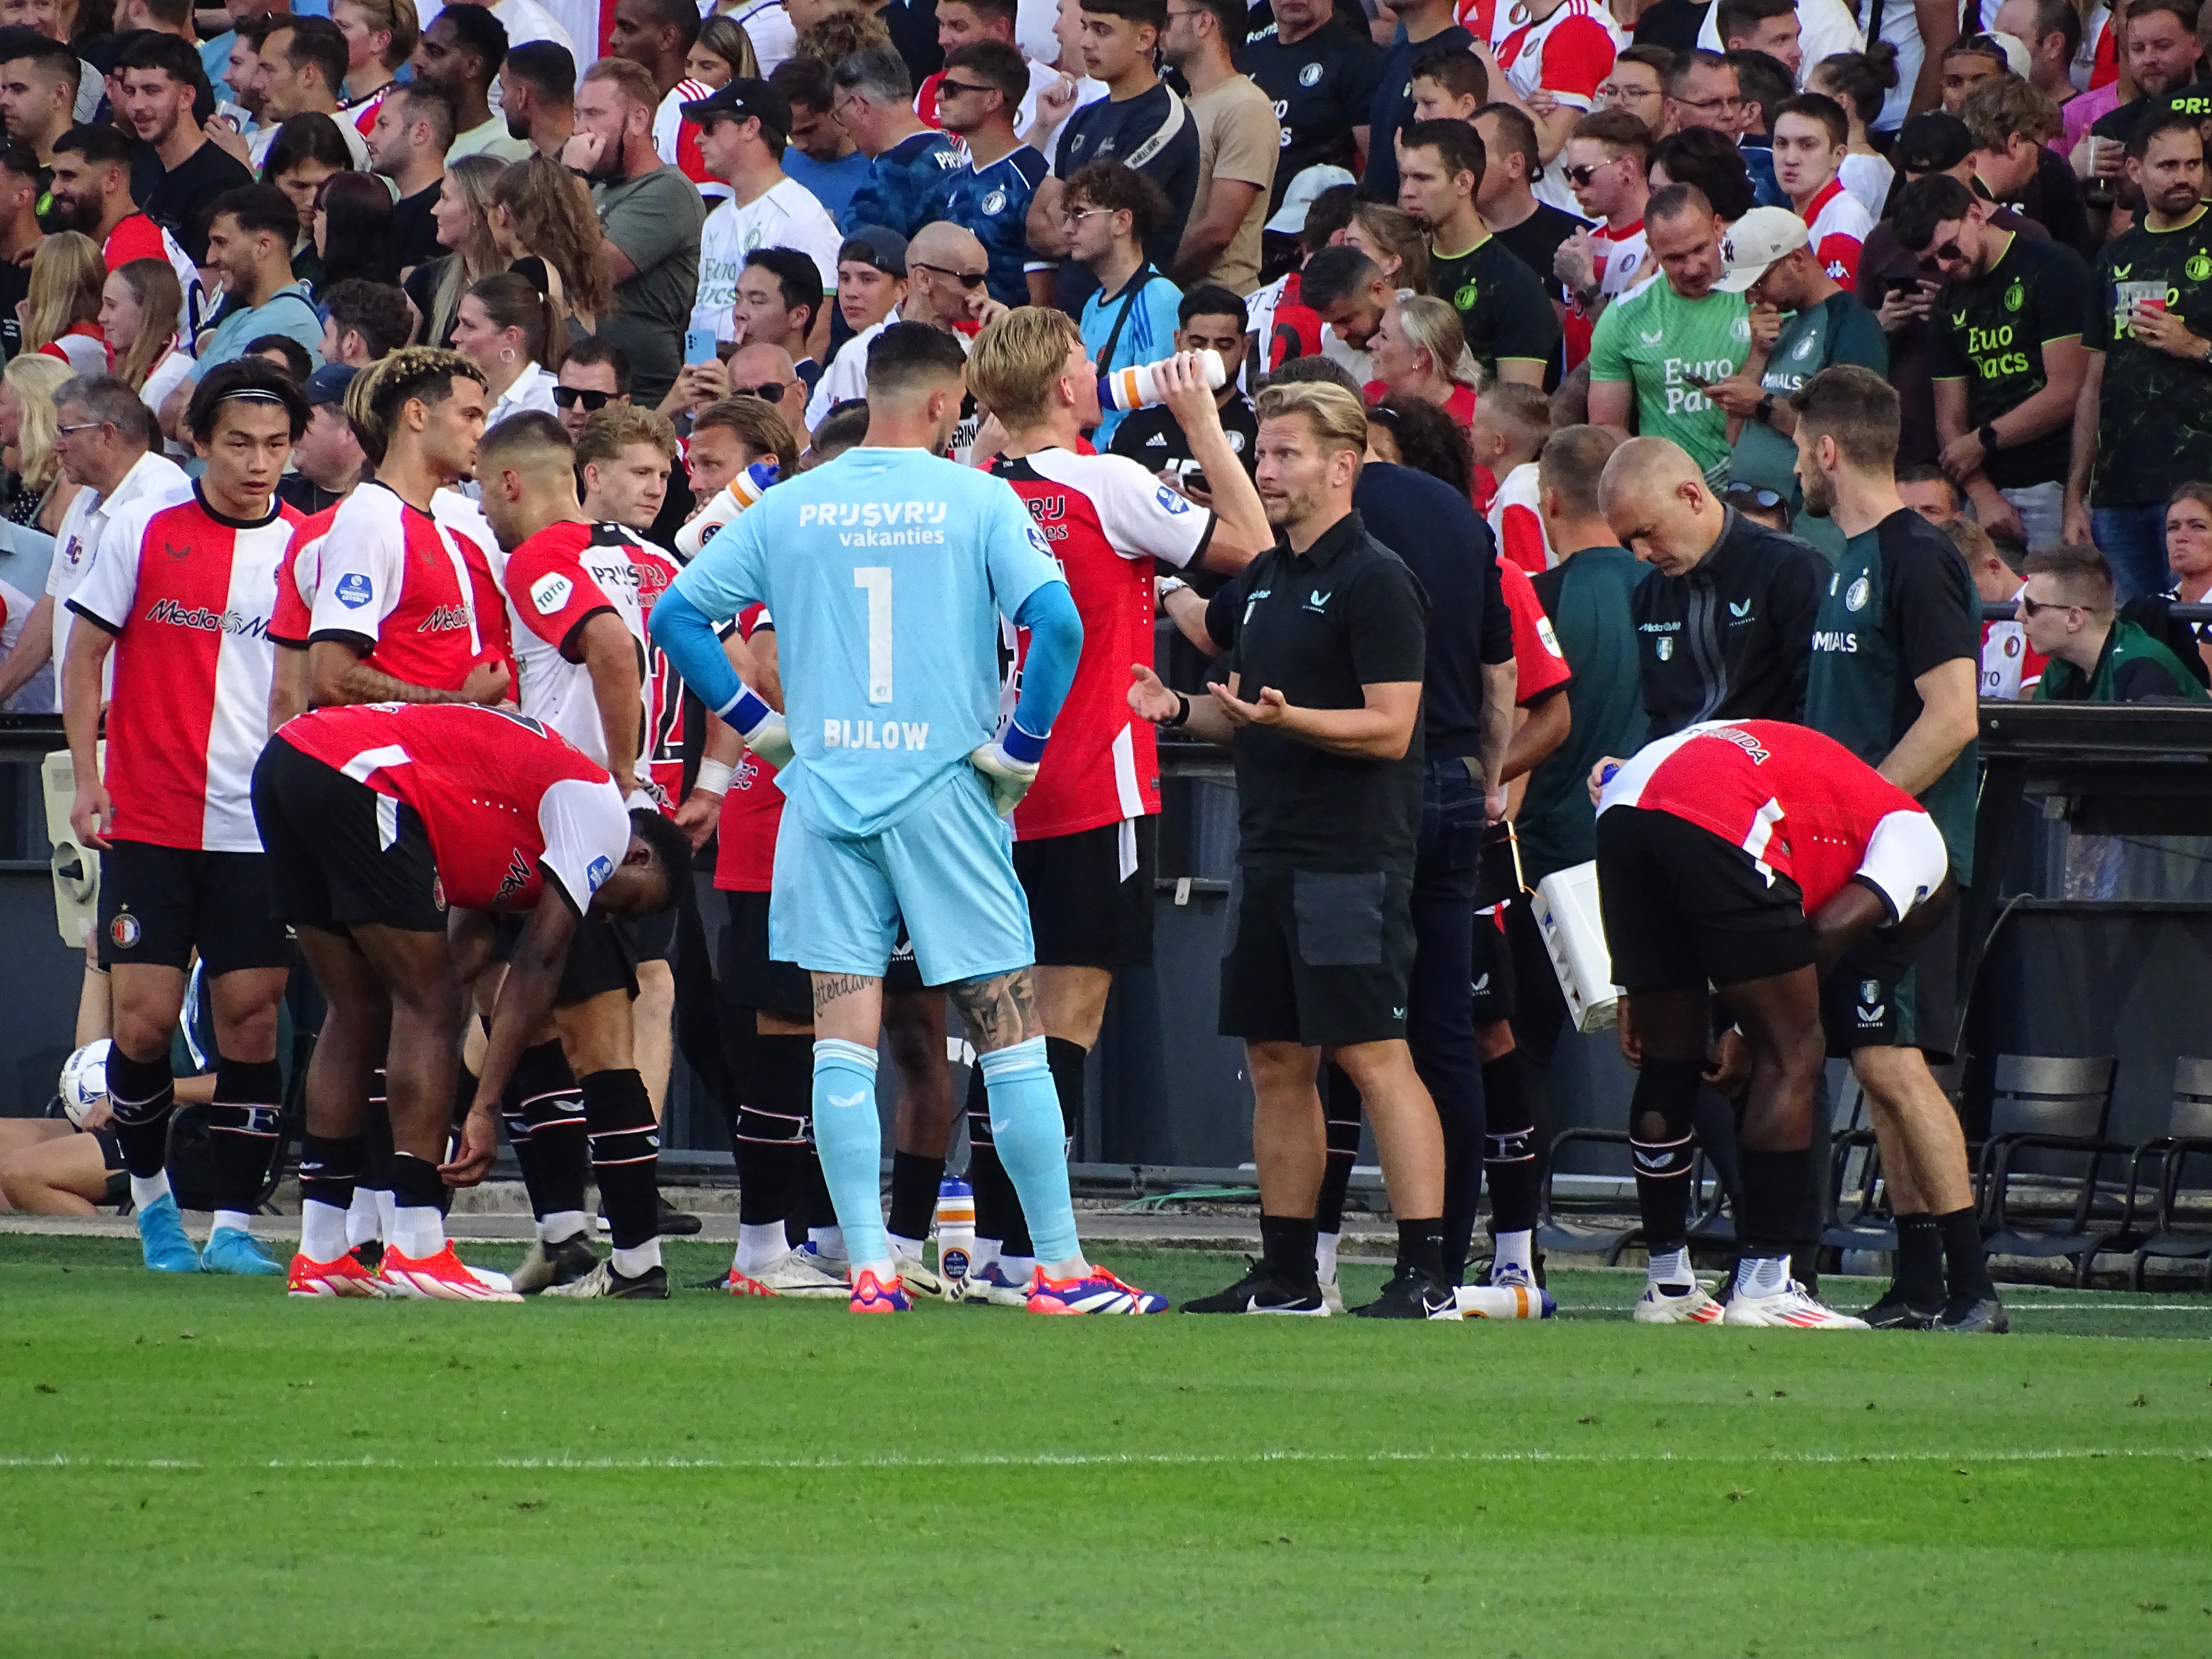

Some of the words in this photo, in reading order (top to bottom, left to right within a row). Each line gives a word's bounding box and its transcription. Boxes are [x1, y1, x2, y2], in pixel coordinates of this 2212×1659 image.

[1664, 358, 1734, 384] Euro
[838, 527, 945, 547] vakanties
[537, 580, 567, 608] TOTO
[146, 598, 221, 631] Media
[854, 567, 893, 703] 1
[1812, 631, 1857, 653] MIALS
[824, 719, 929, 751] BIJLOW
